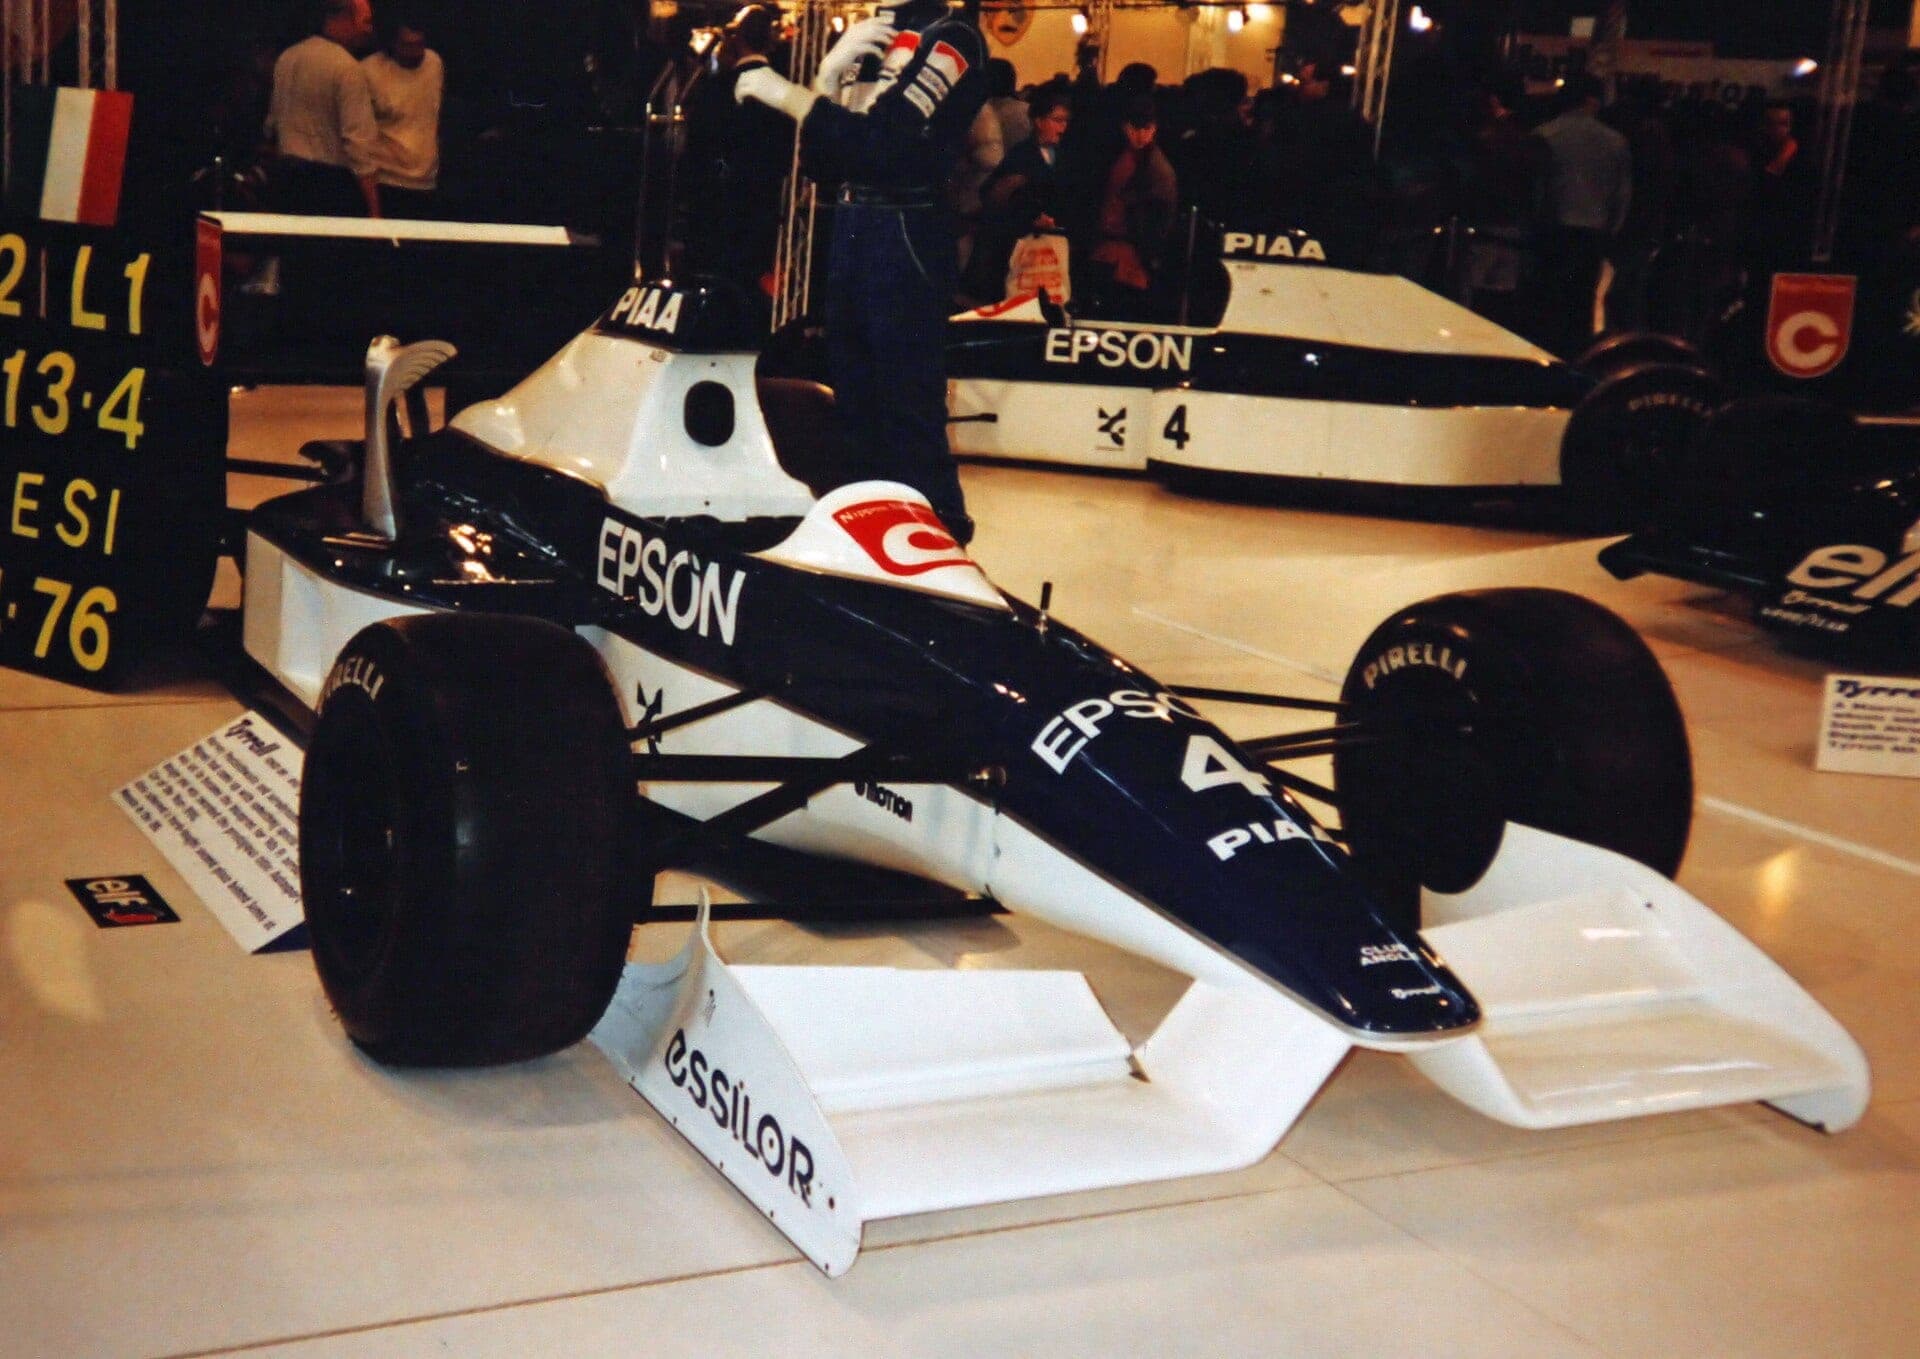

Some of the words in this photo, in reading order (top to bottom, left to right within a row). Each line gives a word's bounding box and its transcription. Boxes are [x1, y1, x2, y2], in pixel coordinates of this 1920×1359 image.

[1223, 232, 1327, 261] PIAA
[610, 287, 683, 334] PIAA
[1045, 328, 1193, 371] EPSON
[1163, 404, 1190, 450] 4
[597, 516, 747, 646] EPSON
[1786, 544, 1920, 607] el
[1363, 643, 1467, 689] PIRELLI
[1181, 735, 1276, 797] 4
